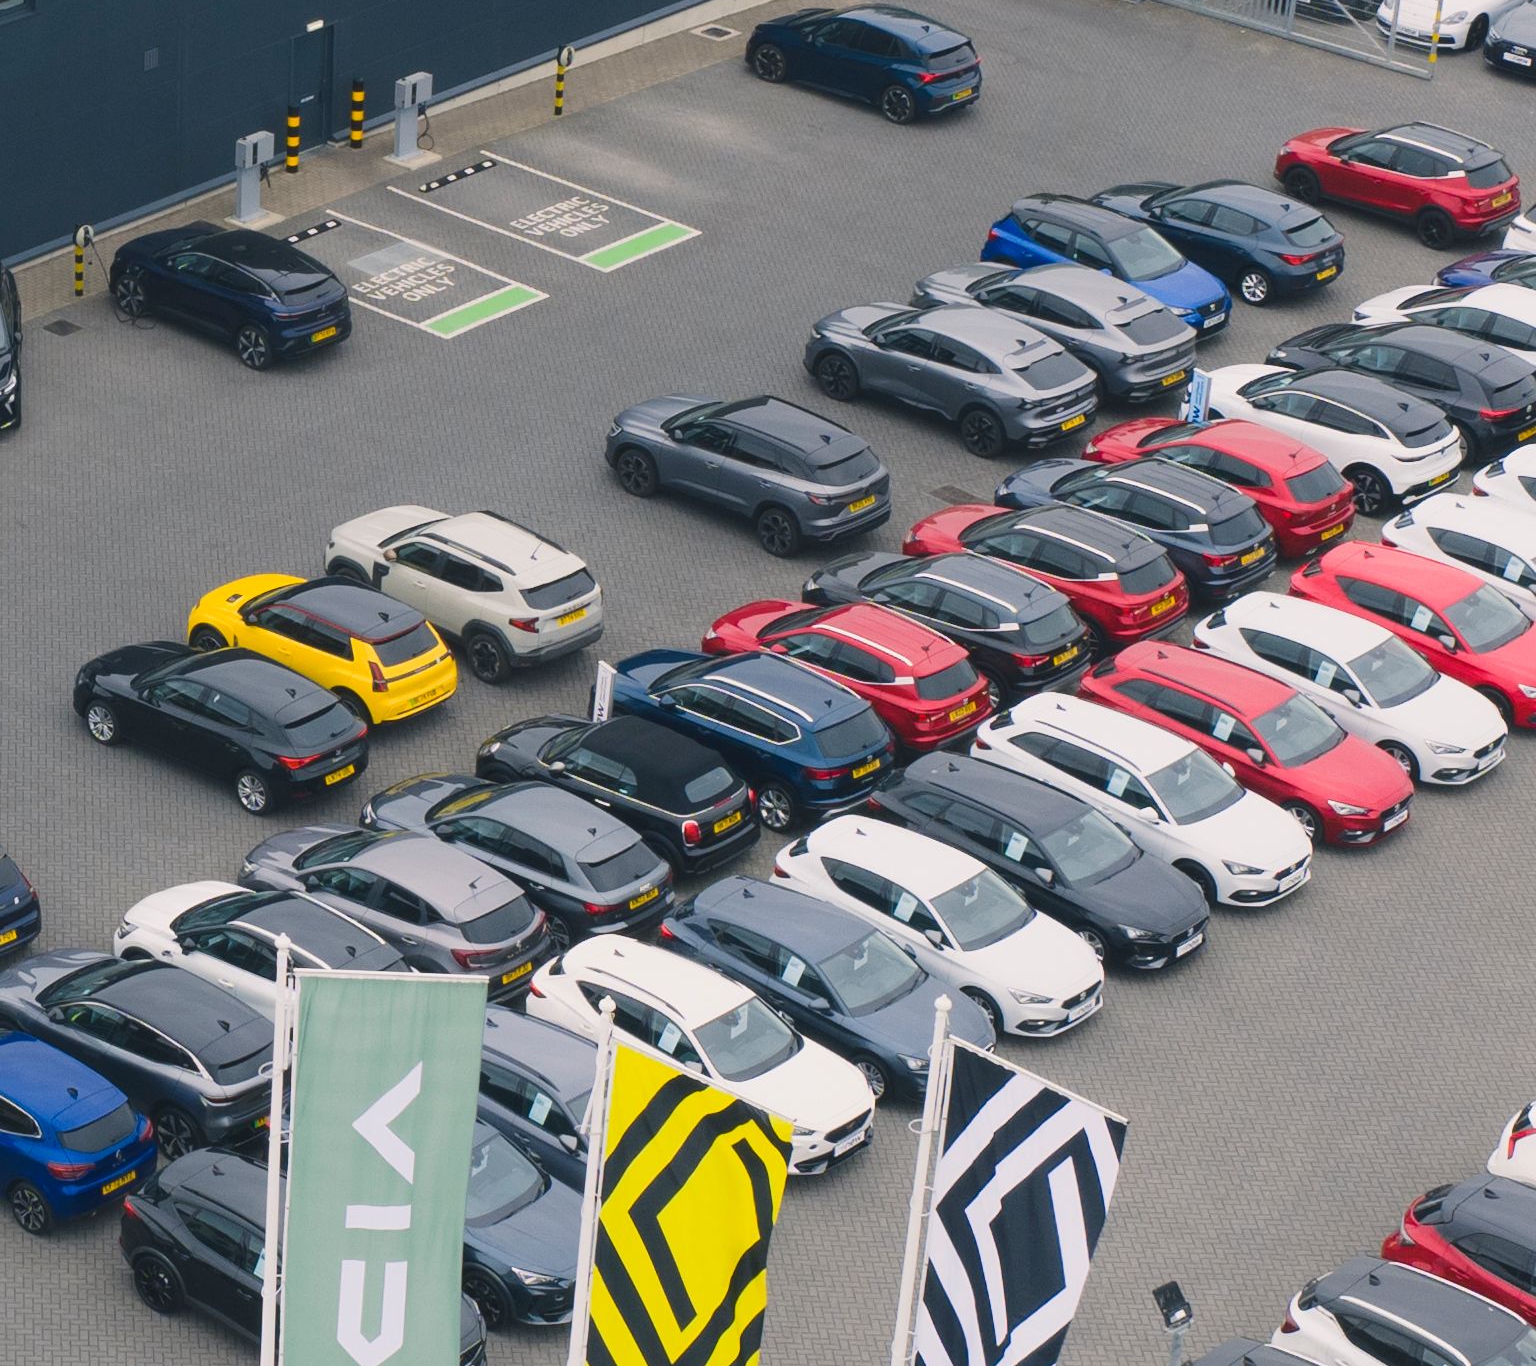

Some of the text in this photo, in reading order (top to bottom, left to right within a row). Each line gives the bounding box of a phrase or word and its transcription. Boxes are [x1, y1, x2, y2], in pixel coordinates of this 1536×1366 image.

[510, 196, 590, 230] ELECTRIC
[525, 202, 610, 237] VEHICLES
[560, 215, 610, 238] ONLY
[352, 256, 436, 293] ELECTRIC
[368, 262, 456, 301] VEHICLES
[402, 276, 456, 302] ONLY
